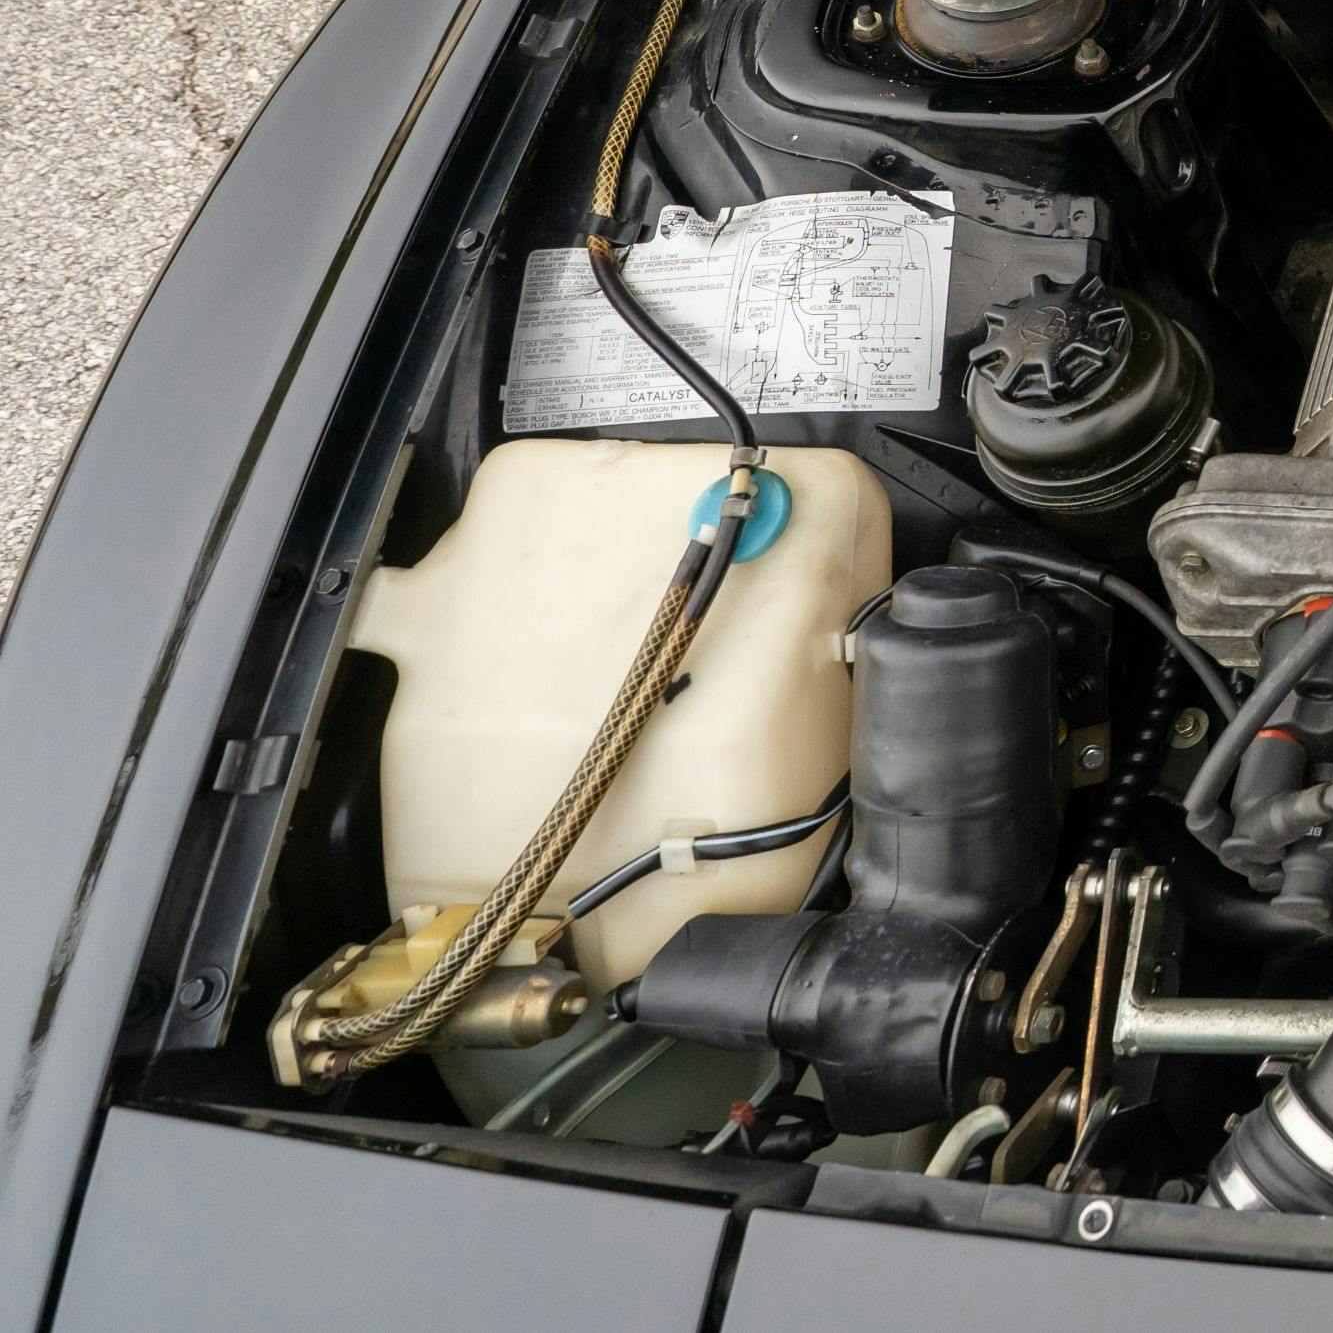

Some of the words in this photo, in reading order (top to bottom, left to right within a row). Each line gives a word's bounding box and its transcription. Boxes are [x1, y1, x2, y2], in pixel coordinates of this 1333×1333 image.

[599, 374, 638, 382] WARRANTY
[560, 384, 600, 393] ADDITIONAL
[603, 380, 650, 390] INFORMATION
[628, 389, 692, 403] CATALYST
[631, 406, 669, 414] CHAMPION
